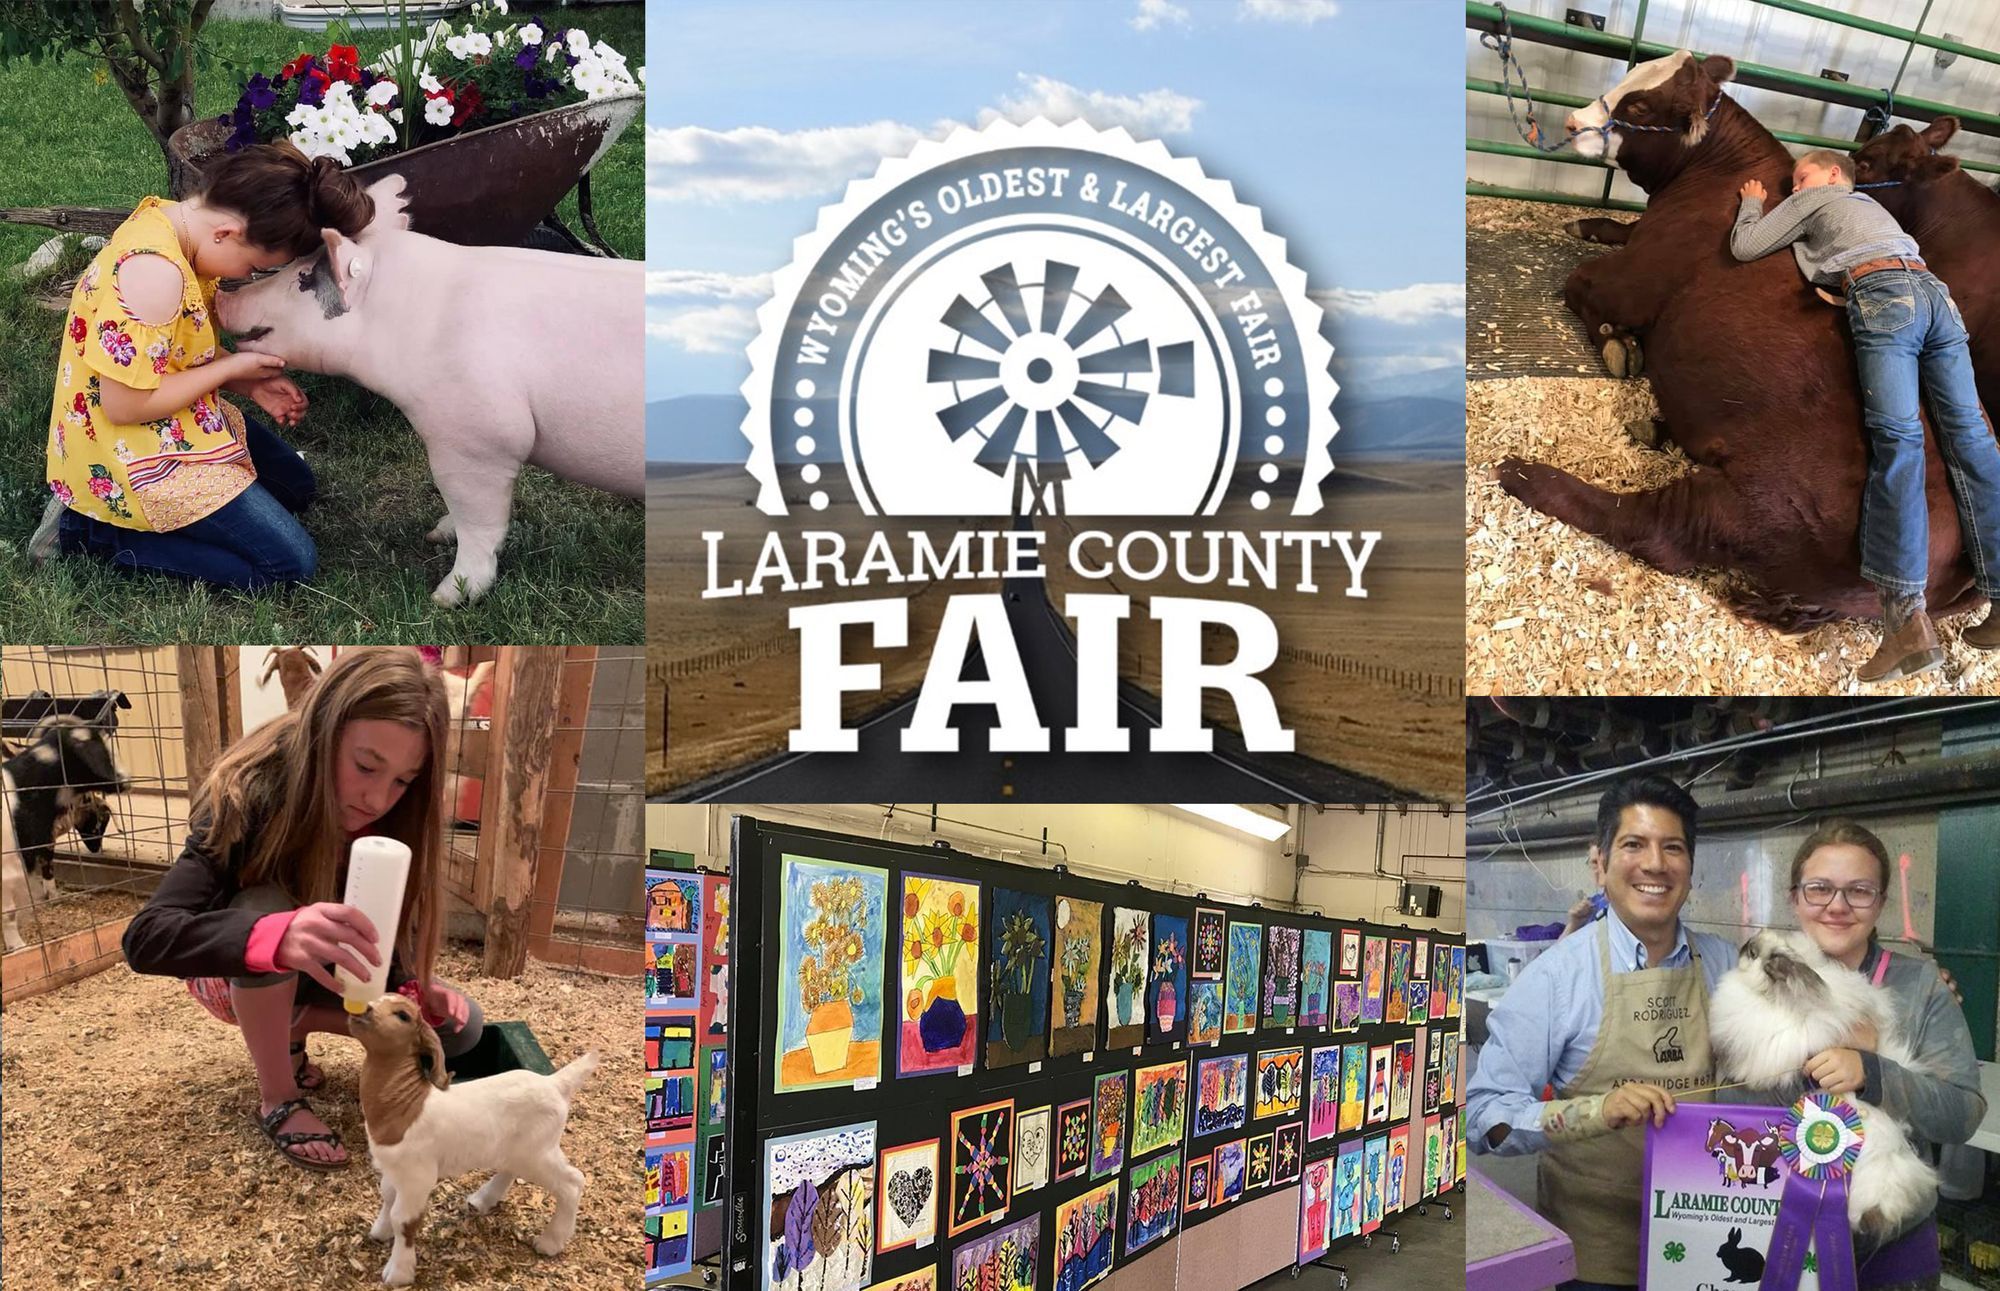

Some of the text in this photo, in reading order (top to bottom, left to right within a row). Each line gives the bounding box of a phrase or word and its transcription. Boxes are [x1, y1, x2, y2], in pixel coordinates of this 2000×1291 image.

[1647, 996, 1677, 1008] SCOTT
[1633, 1007, 1691, 1021] RODRIGUEZ
[1654, 1189, 1781, 1219] LARAMIE COUNT
[1671, 1211, 1709, 1222] Wyoming's
[1711, 1214, 1733, 1223] Oldest
[1748, 1217, 1775, 1227] Largest
